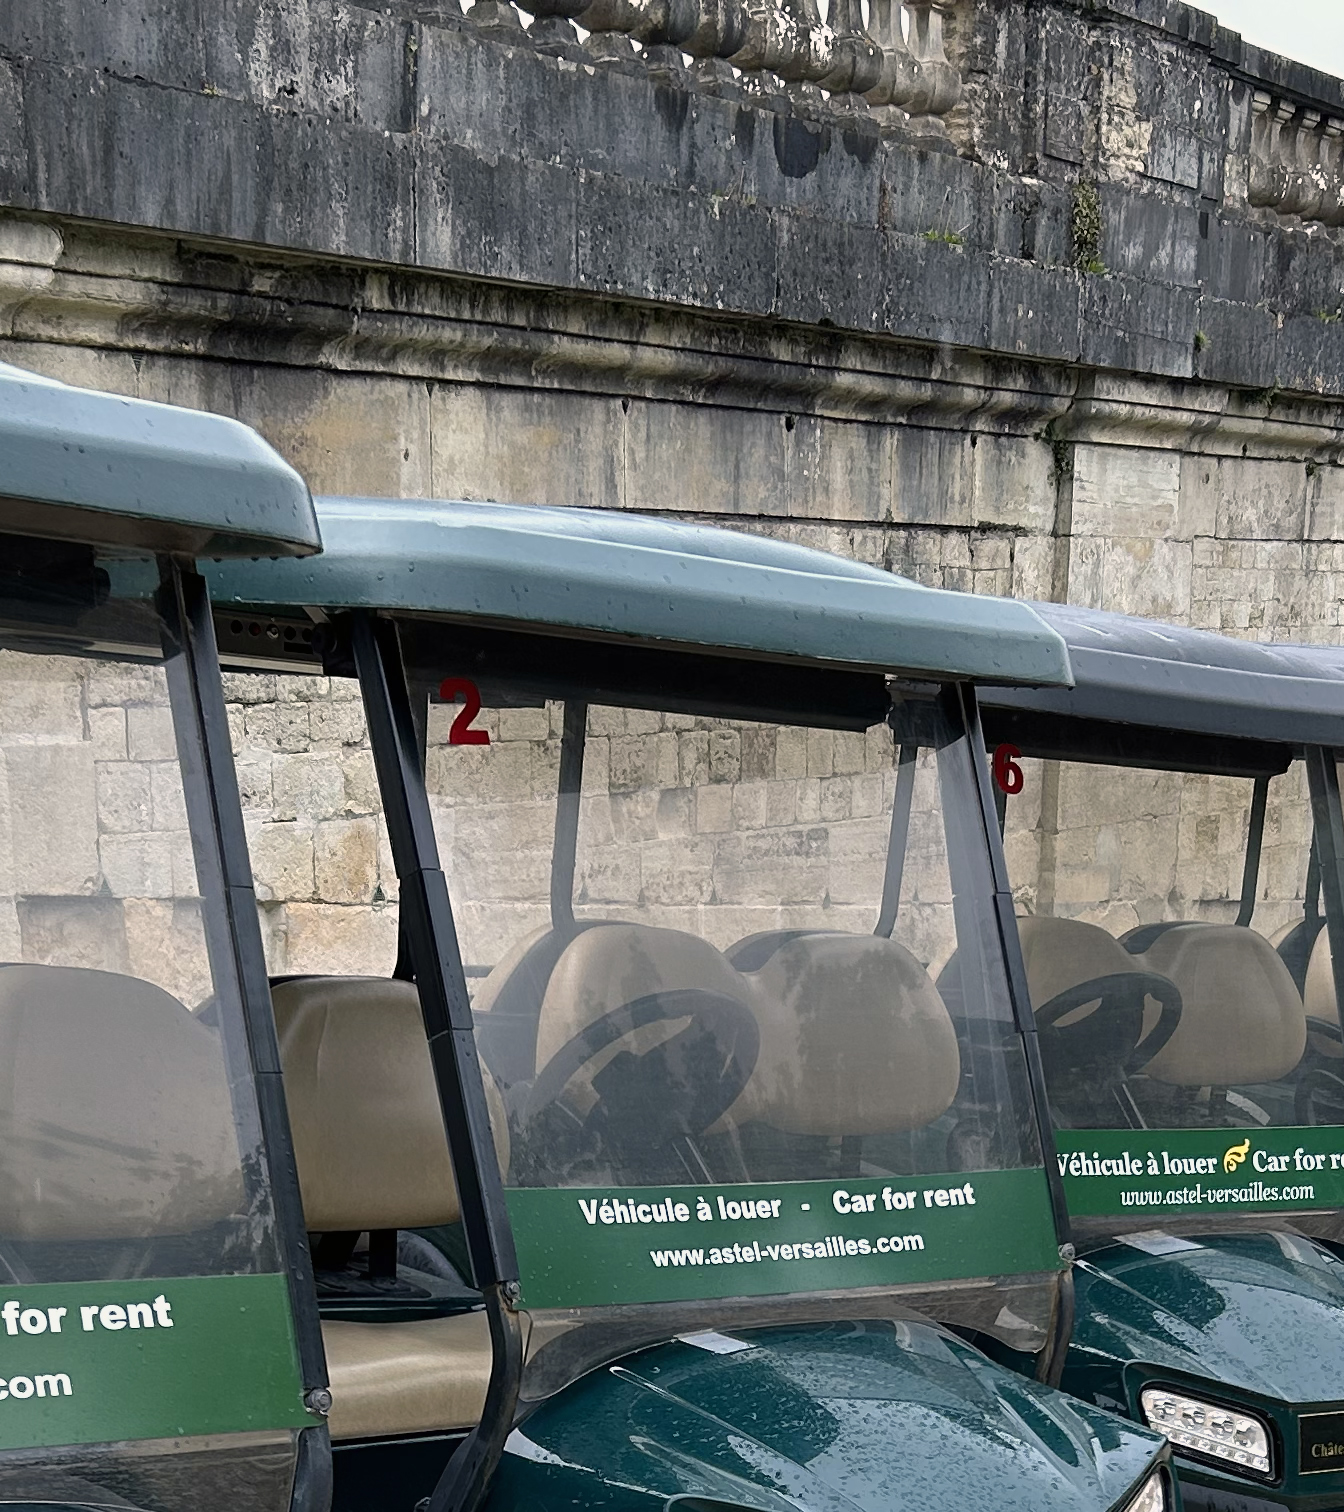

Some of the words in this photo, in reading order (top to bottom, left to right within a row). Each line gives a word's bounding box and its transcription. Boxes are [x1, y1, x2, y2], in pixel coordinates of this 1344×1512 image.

[439, 677, 490, 746] 2
[993, 743, 1024, 795] 6
[1056, 1151, 1144, 1177] Véhicule
[1146, 1151, 1161, 1175] à
[1164, 1151, 1217, 1175] louer
[1252, 1149, 1290, 1172] Car
[1293, 1147, 1326, 1172] for
[578, 1197, 690, 1225] Véhicule
[697, 1196, 713, 1222] à
[718, 1195, 782, 1220] louer
[832, 1189, 876, 1215] Car
[881, 1186, 917, 1211] for
[923, 1182, 976, 1208] rent
[1120, 1182, 1315, 1206] www.astel-versailles.com
[650, 1233, 925, 1267] www.astel-versailles.com
[1, 1300, 67, 1336] for
[80, 1294, 175, 1332] rent
